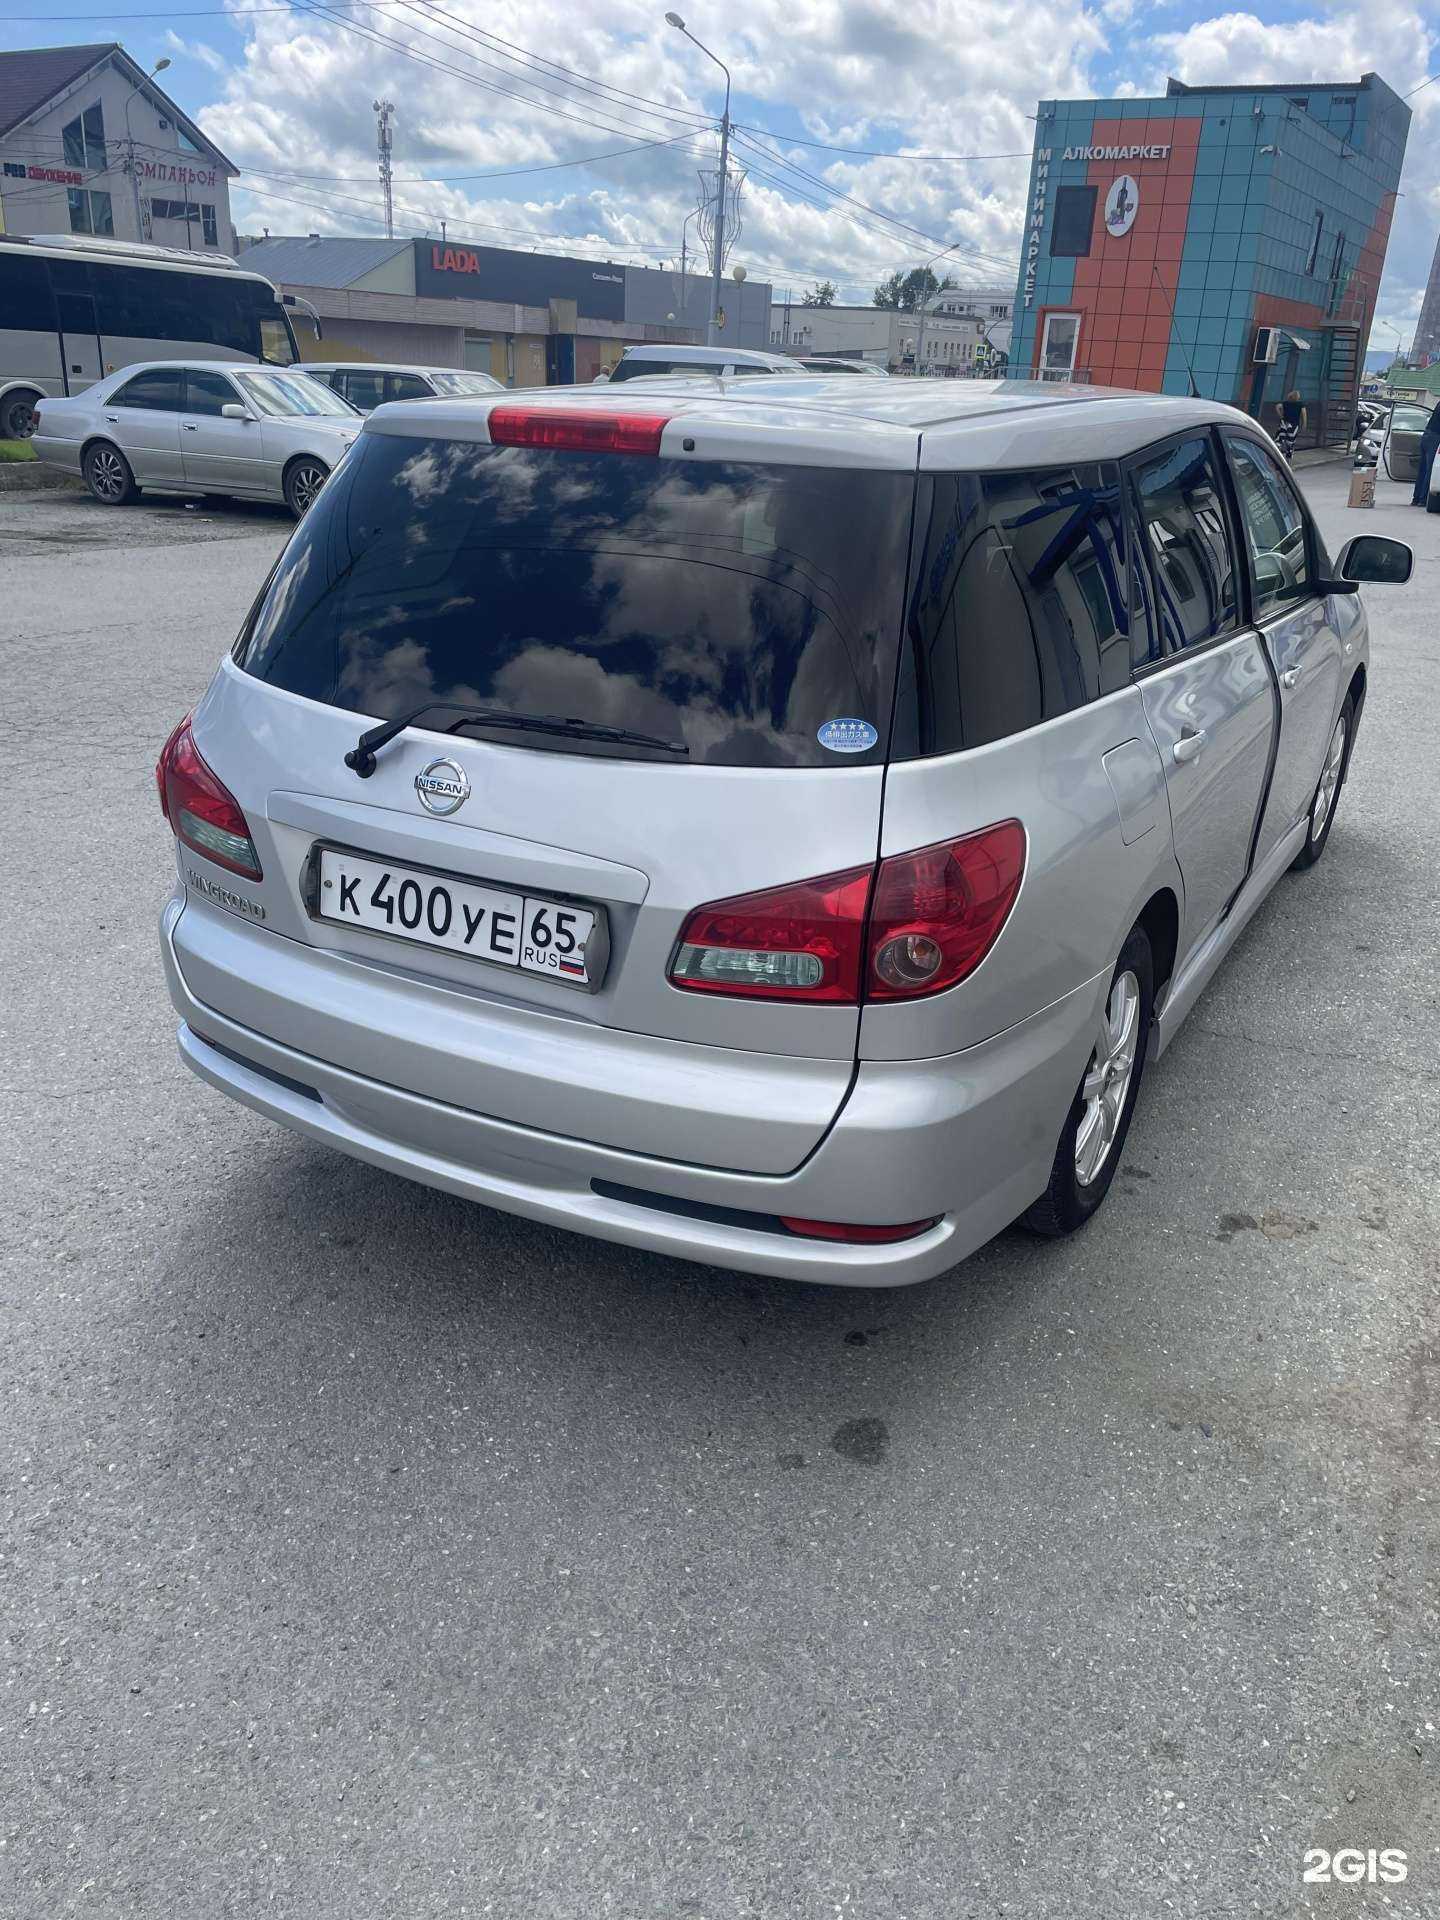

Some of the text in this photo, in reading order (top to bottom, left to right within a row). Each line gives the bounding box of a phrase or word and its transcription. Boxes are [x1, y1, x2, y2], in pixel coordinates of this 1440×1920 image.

[1062, 144, 1171, 161] АЛКОМАРКЕТ
[1024, 148, 1051, 307] МИНИМАРКЕТ
[432, 246, 480, 275] LADA
[418, 777, 463, 795] NISSAN
[530, 908, 577, 953] 65
[524, 947, 558, 968] RUS
